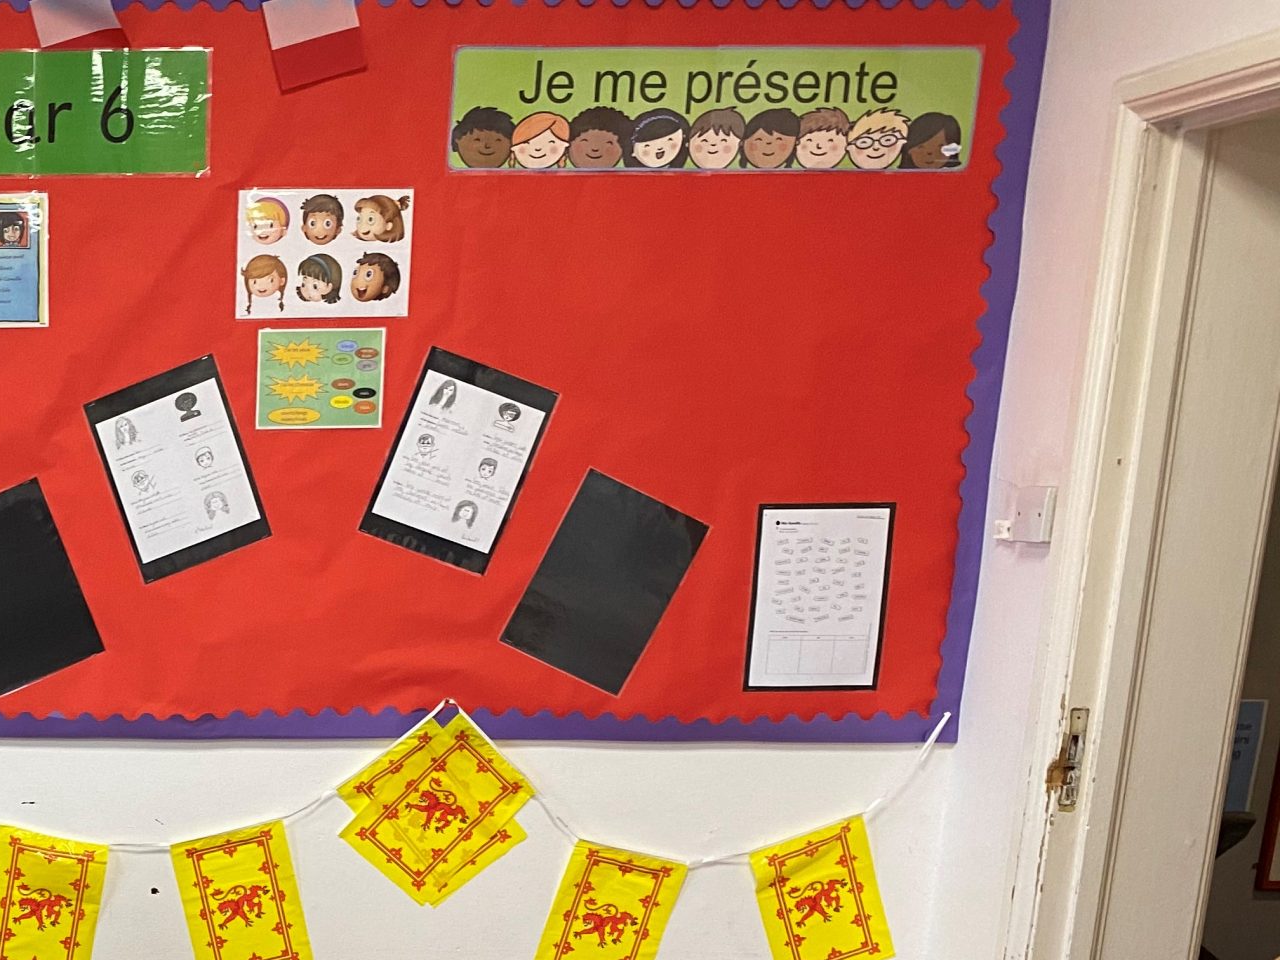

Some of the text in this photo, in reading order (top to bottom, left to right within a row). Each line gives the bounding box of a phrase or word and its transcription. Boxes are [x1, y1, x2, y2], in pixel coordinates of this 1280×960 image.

[518, 60, 899, 114] Je me présente
[100, 86, 135, 145] 6
